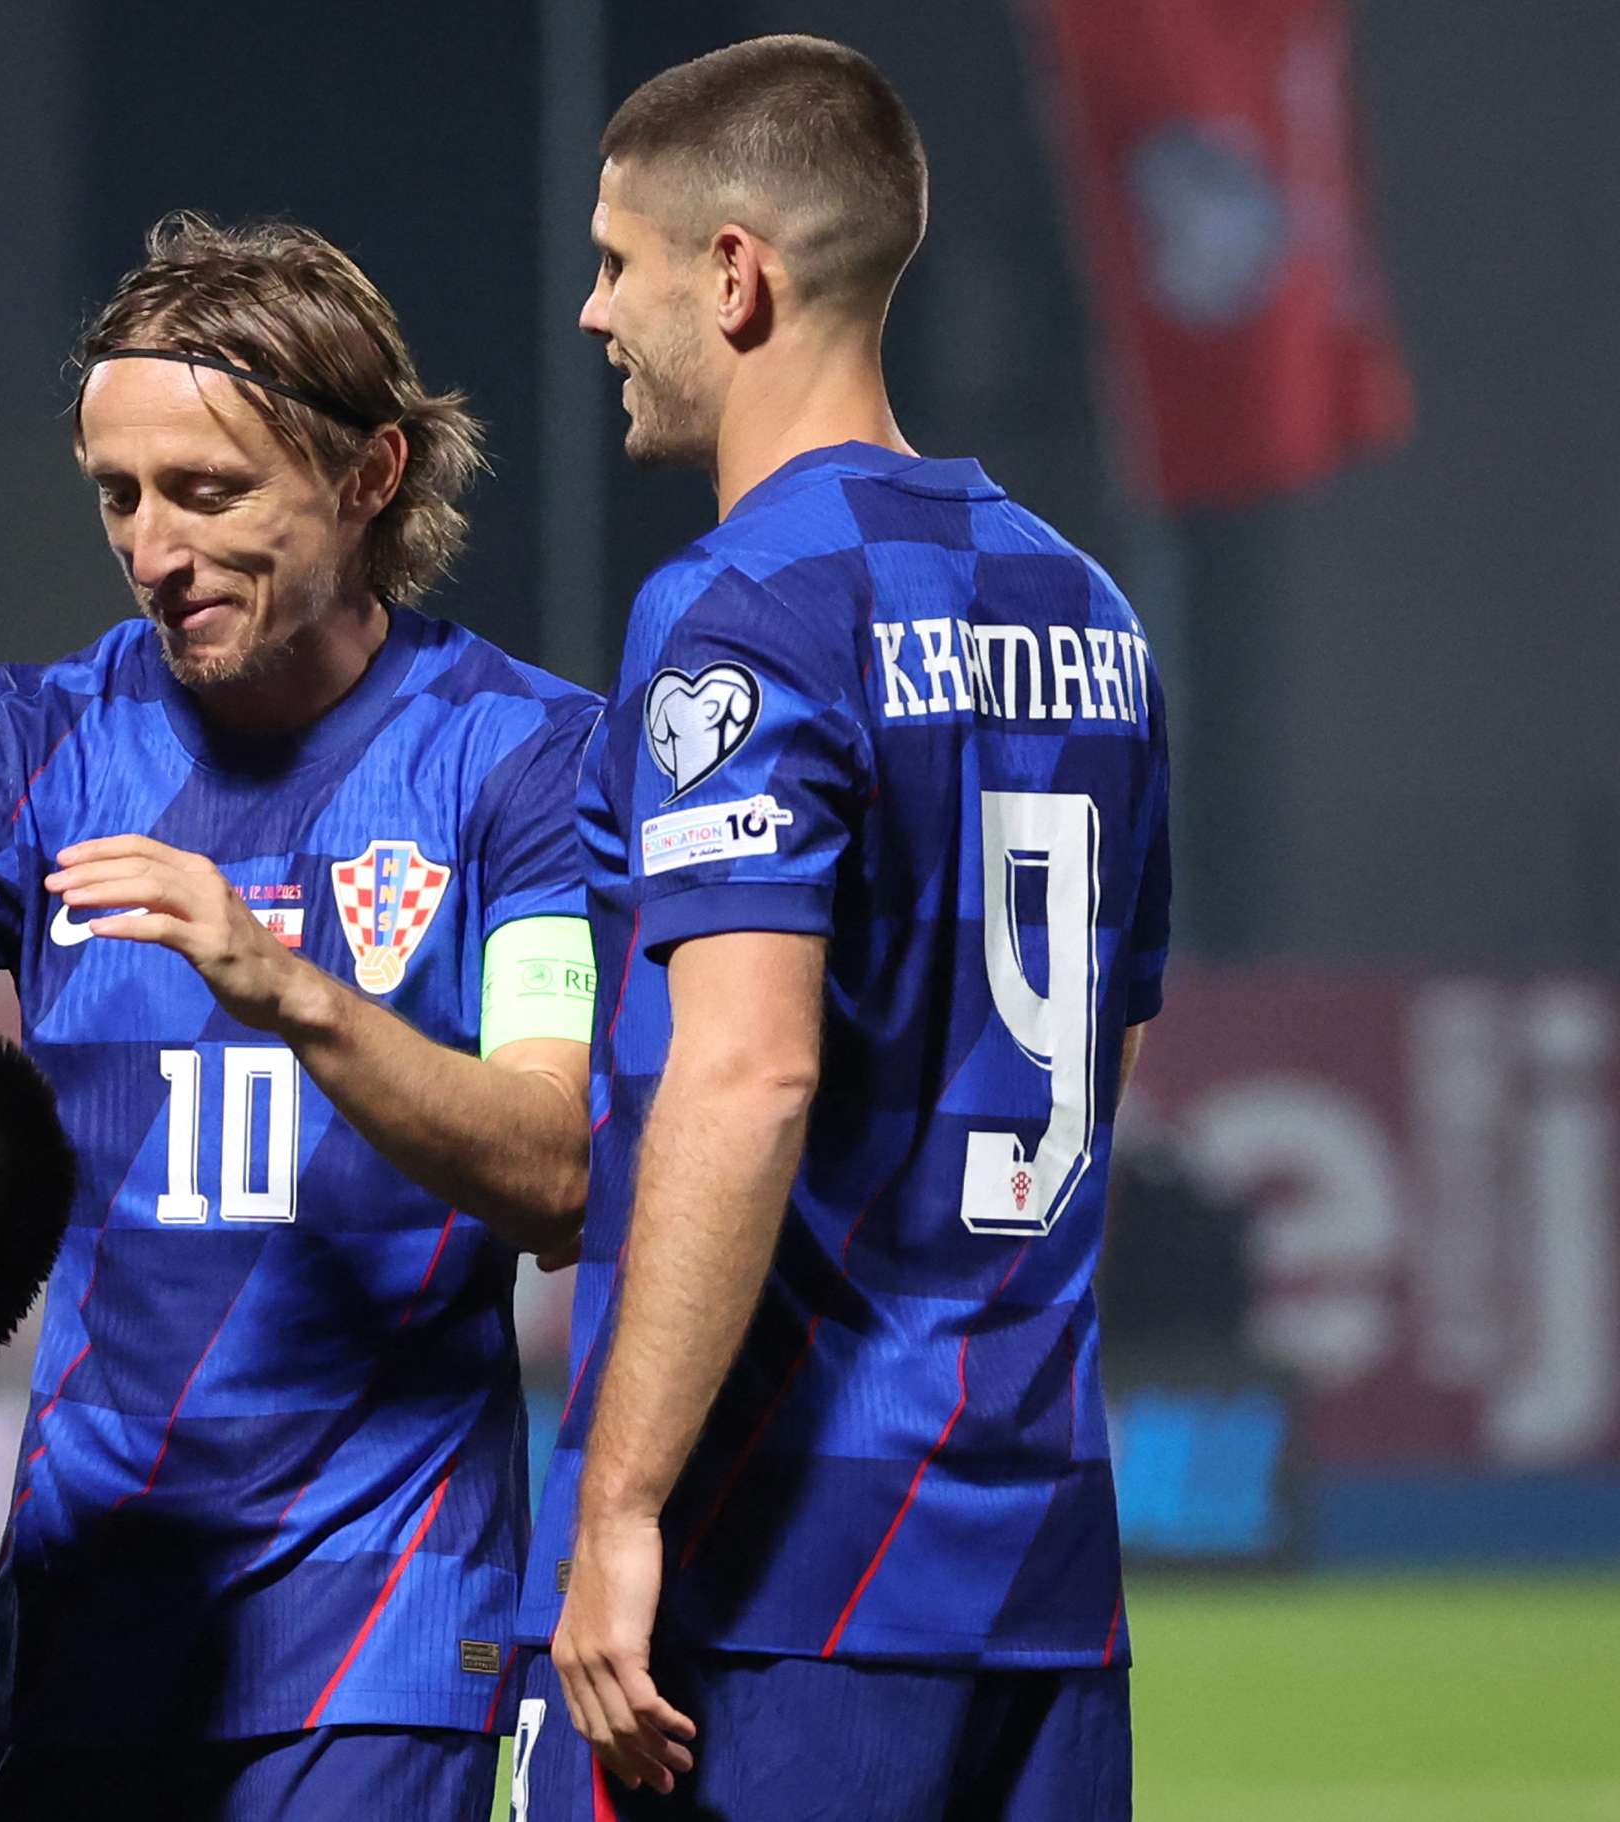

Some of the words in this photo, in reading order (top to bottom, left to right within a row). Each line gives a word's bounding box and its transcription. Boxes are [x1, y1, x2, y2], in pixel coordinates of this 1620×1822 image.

[725, 810, 768, 841] 10
[960, 791, 1100, 1237] 9
[157, 1047, 300, 1224] 10
